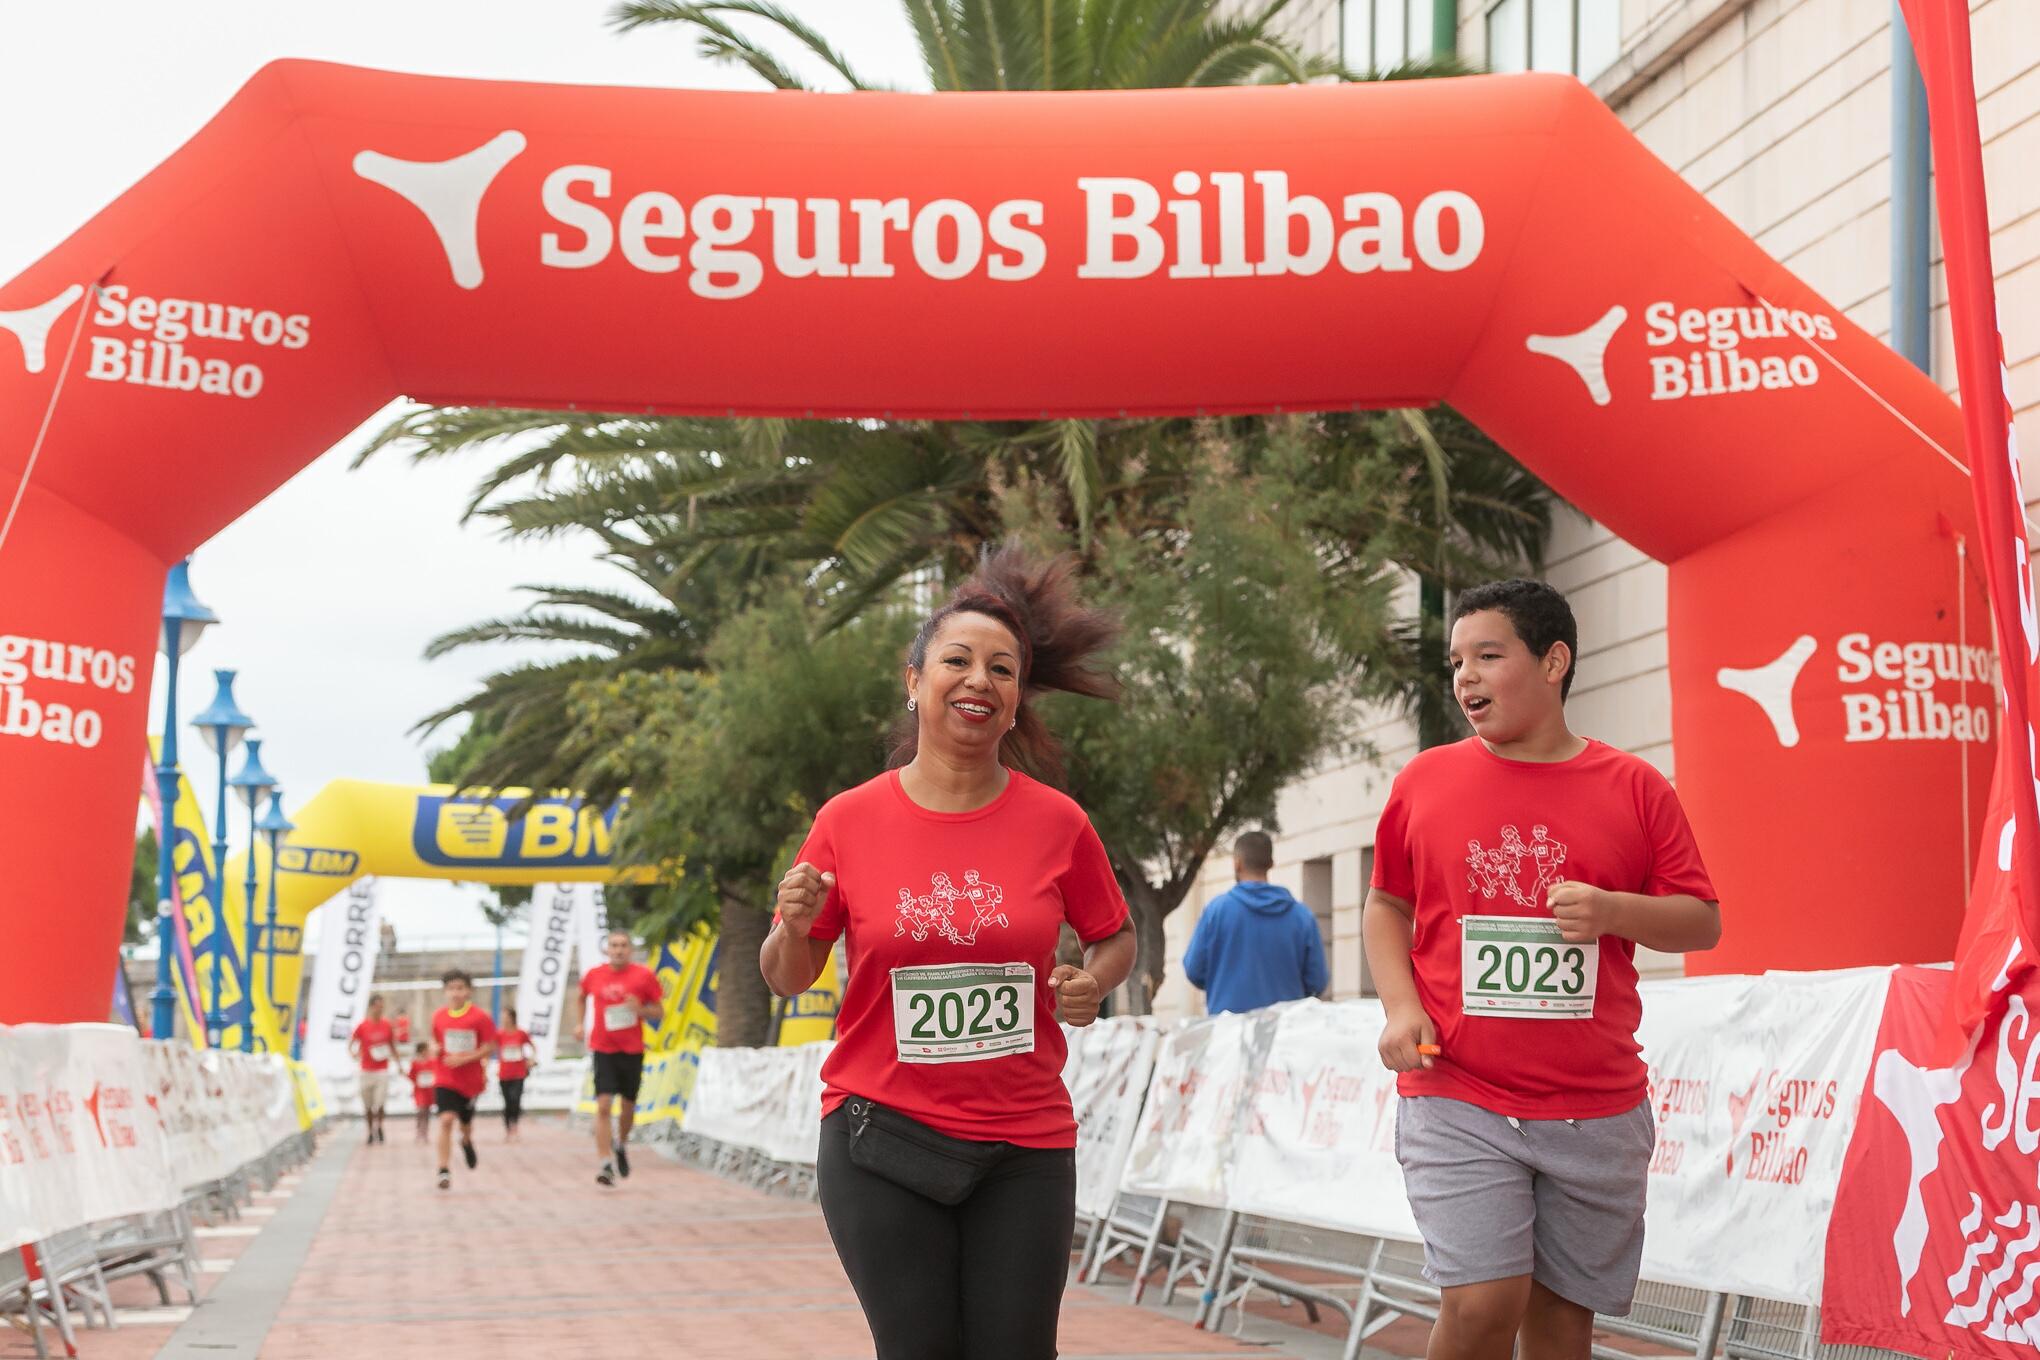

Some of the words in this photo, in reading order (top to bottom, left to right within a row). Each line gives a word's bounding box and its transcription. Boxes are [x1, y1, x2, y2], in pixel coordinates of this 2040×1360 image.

[541, 164, 1046, 299] Seguros
[1077, 170, 1485, 280] Bilbao
[94, 284, 311, 349] Seguros
[1645, 301, 1838, 350] Seguros
[86, 336, 263, 398] Bilbao
[1649, 350, 1819, 400] Bilbao
[0, 634, 135, 694] guros
[0, 684, 102, 748] bao
[1842, 689, 1989, 743] Bilbao
[519, 803, 628, 859] BM
[1477, 944, 1585, 995] 2023
[331, 1008, 356, 1040] EL
[529, 1003, 552, 1038] EL
[909, 985, 1020, 1039] 2023
[1744, 1131, 1808, 1185] Bilbao
